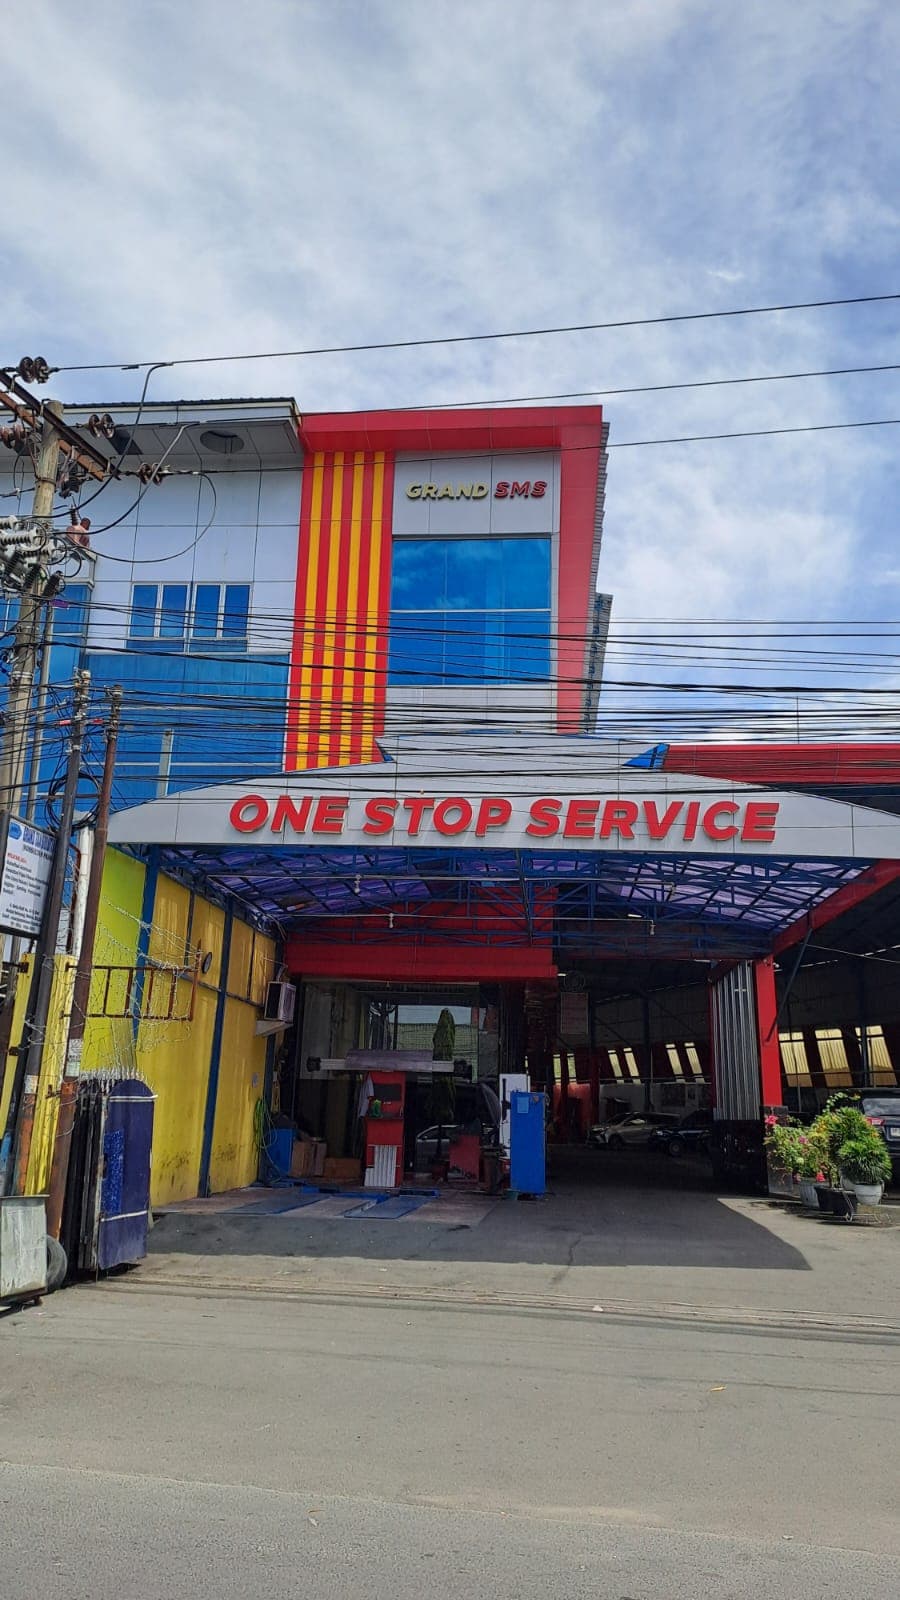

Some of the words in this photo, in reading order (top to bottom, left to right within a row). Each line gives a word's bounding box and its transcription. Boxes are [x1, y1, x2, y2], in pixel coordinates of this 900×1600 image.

[406, 481, 489, 500] GRAND
[494, 480, 548, 499] SMS
[229, 793, 350, 836] ONE
[363, 797, 513, 837] STOP
[525, 798, 780, 842] SERVICE
